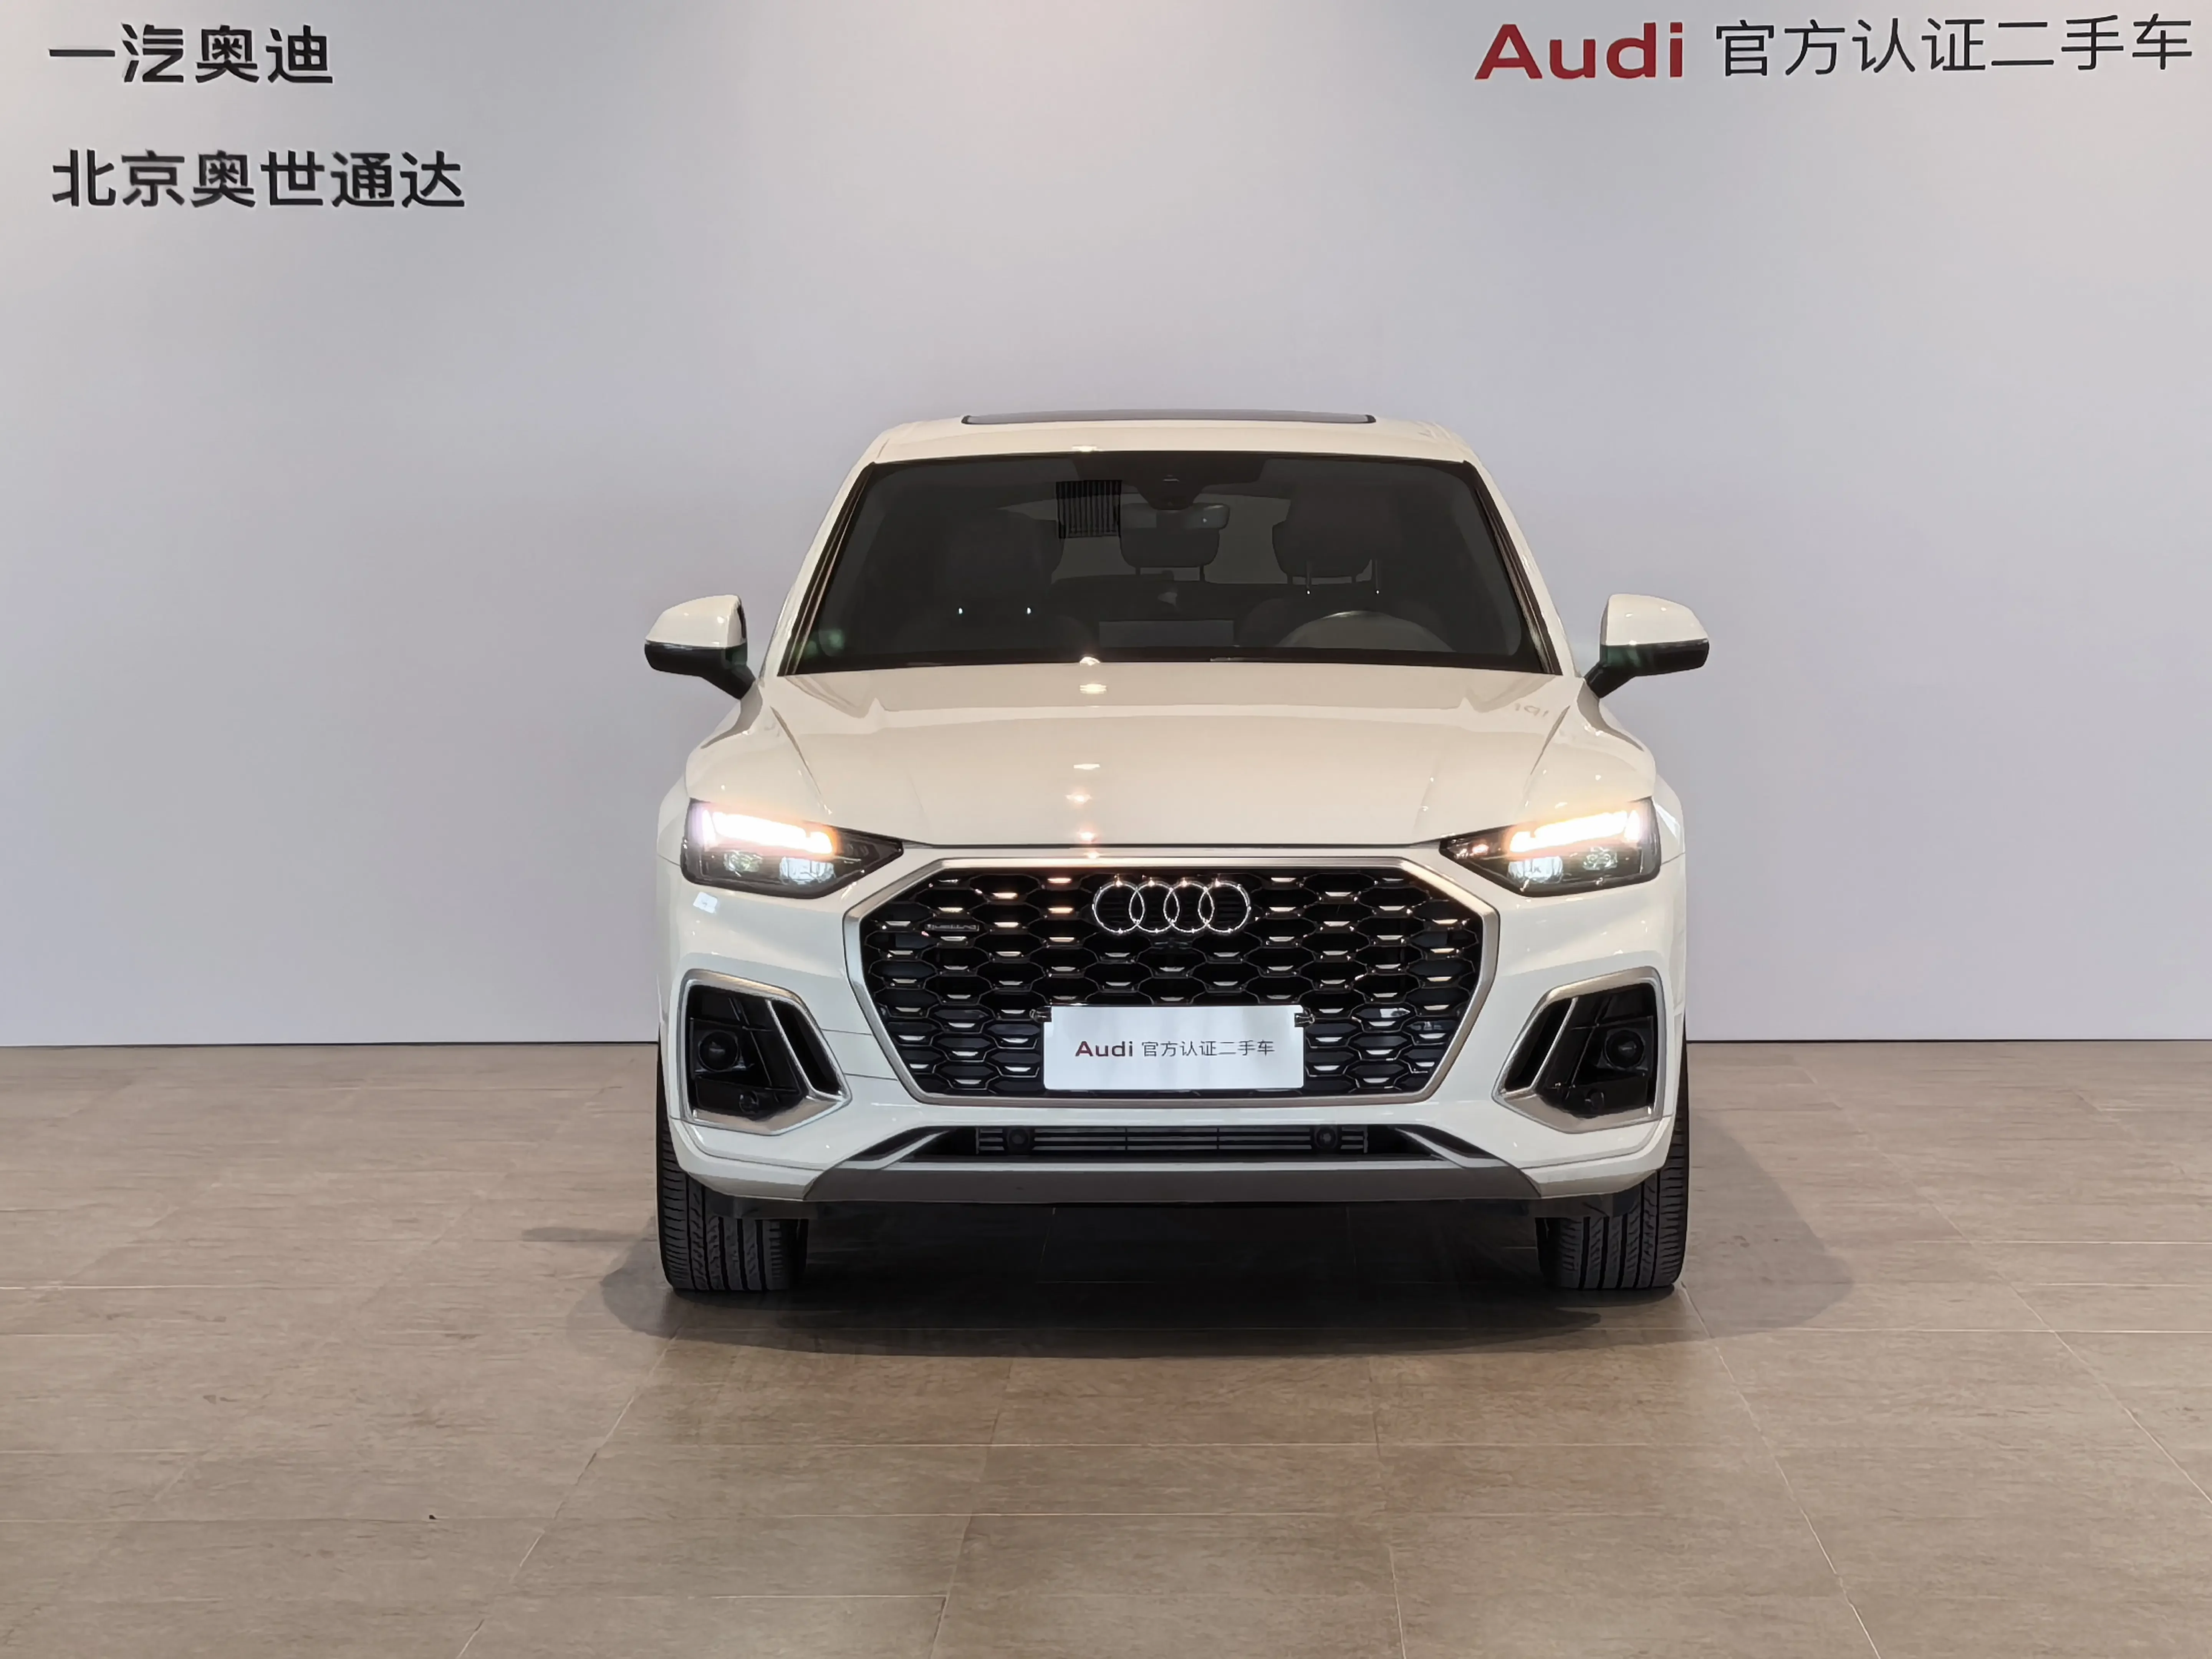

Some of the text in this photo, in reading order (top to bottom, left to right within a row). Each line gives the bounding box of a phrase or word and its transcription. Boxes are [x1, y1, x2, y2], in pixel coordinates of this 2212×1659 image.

[50, 24, 333, 84] 一汽奥迪
[1475, 13, 2192, 79] Audi 官方认证二手车
[52, 149, 465, 208] 北京奥世通达
[1075, 1040, 1275, 1057] Audi 官方认证二手车
